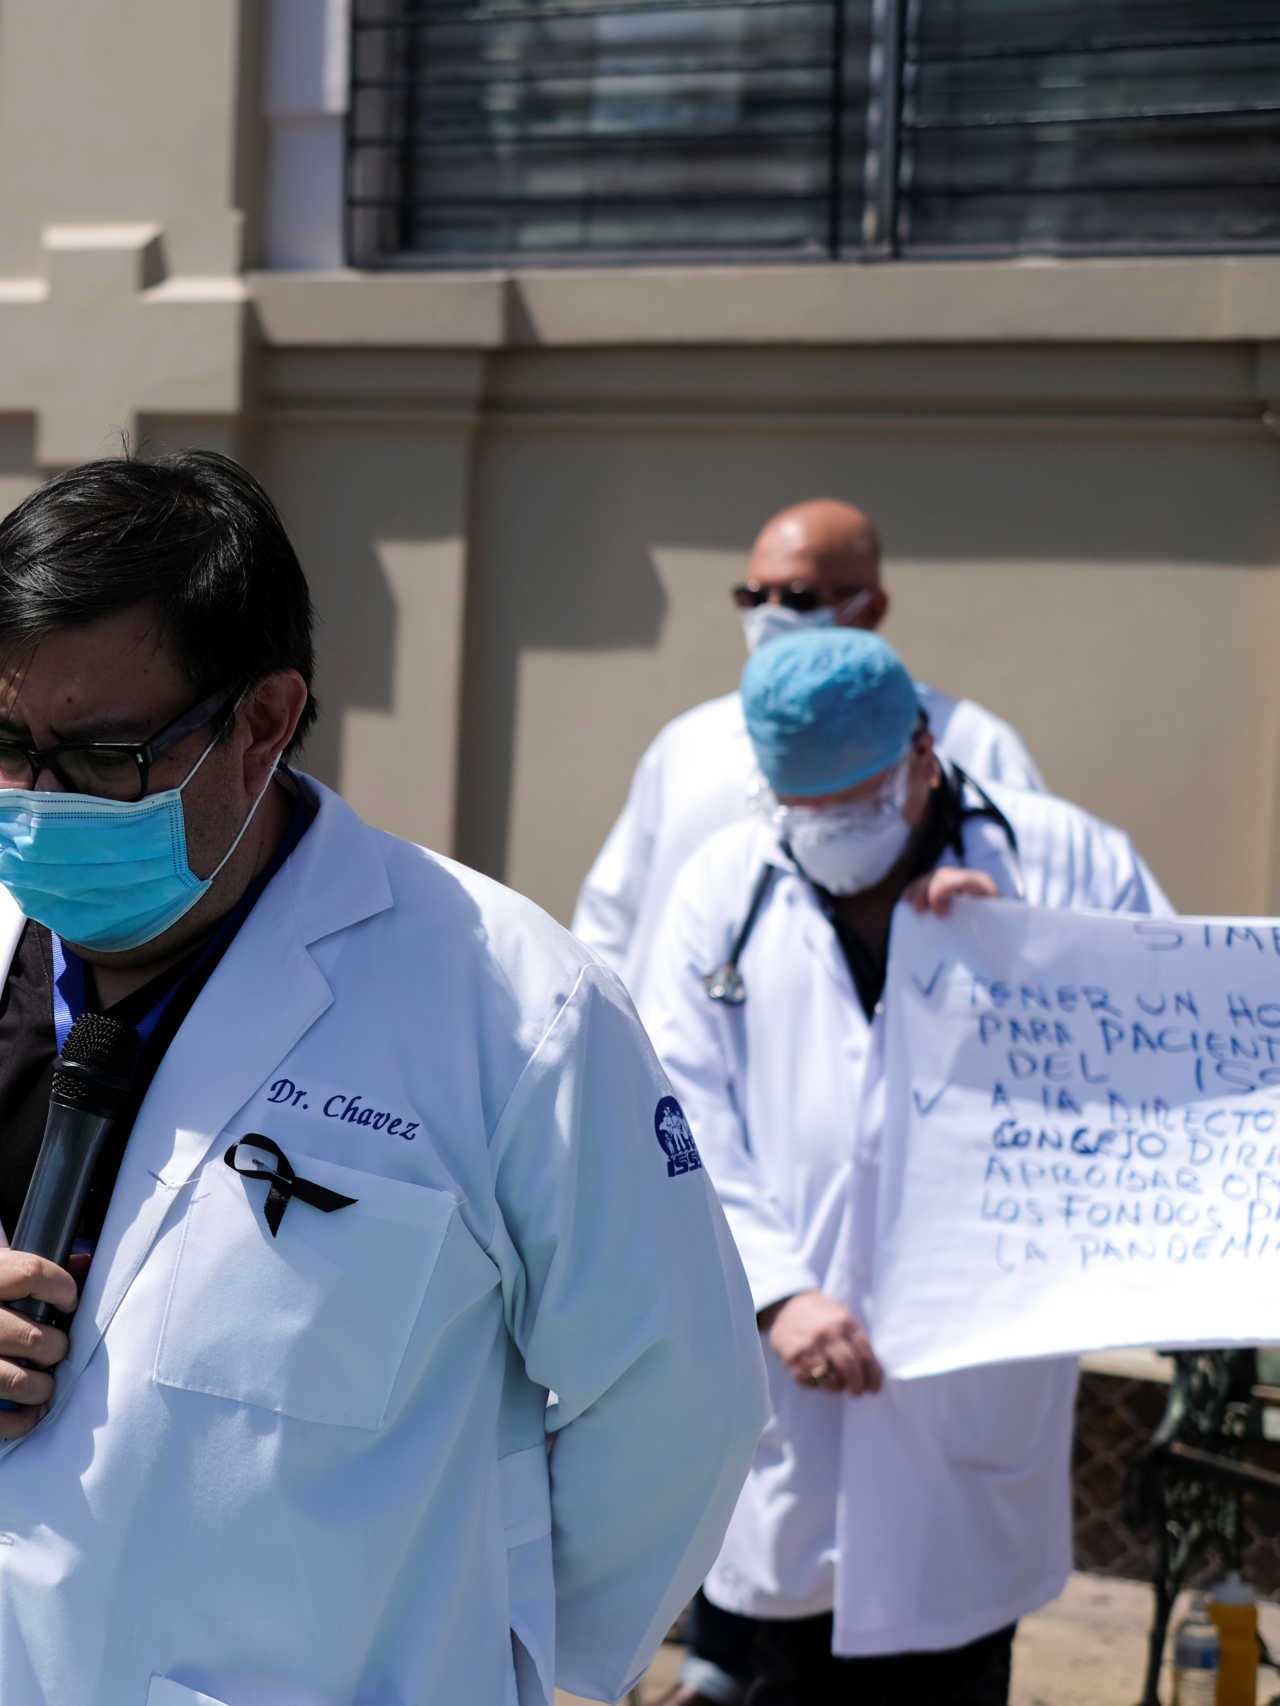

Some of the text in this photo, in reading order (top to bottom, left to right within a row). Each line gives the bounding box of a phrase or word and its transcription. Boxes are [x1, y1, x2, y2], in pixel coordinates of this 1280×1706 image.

[1136, 988, 1199, 1022] UN
[978, 1012, 1073, 1047] PARA
[1008, 1049, 1110, 1085] DEL
[267, 1078, 420, 1141] Dr. Chavez
[991, 1079, 1013, 1113] A
[981, 1190, 1045, 1228] LOS
[1057, 1192, 1223, 1233] FONDOS
[995, 1231, 1049, 1274] LA
